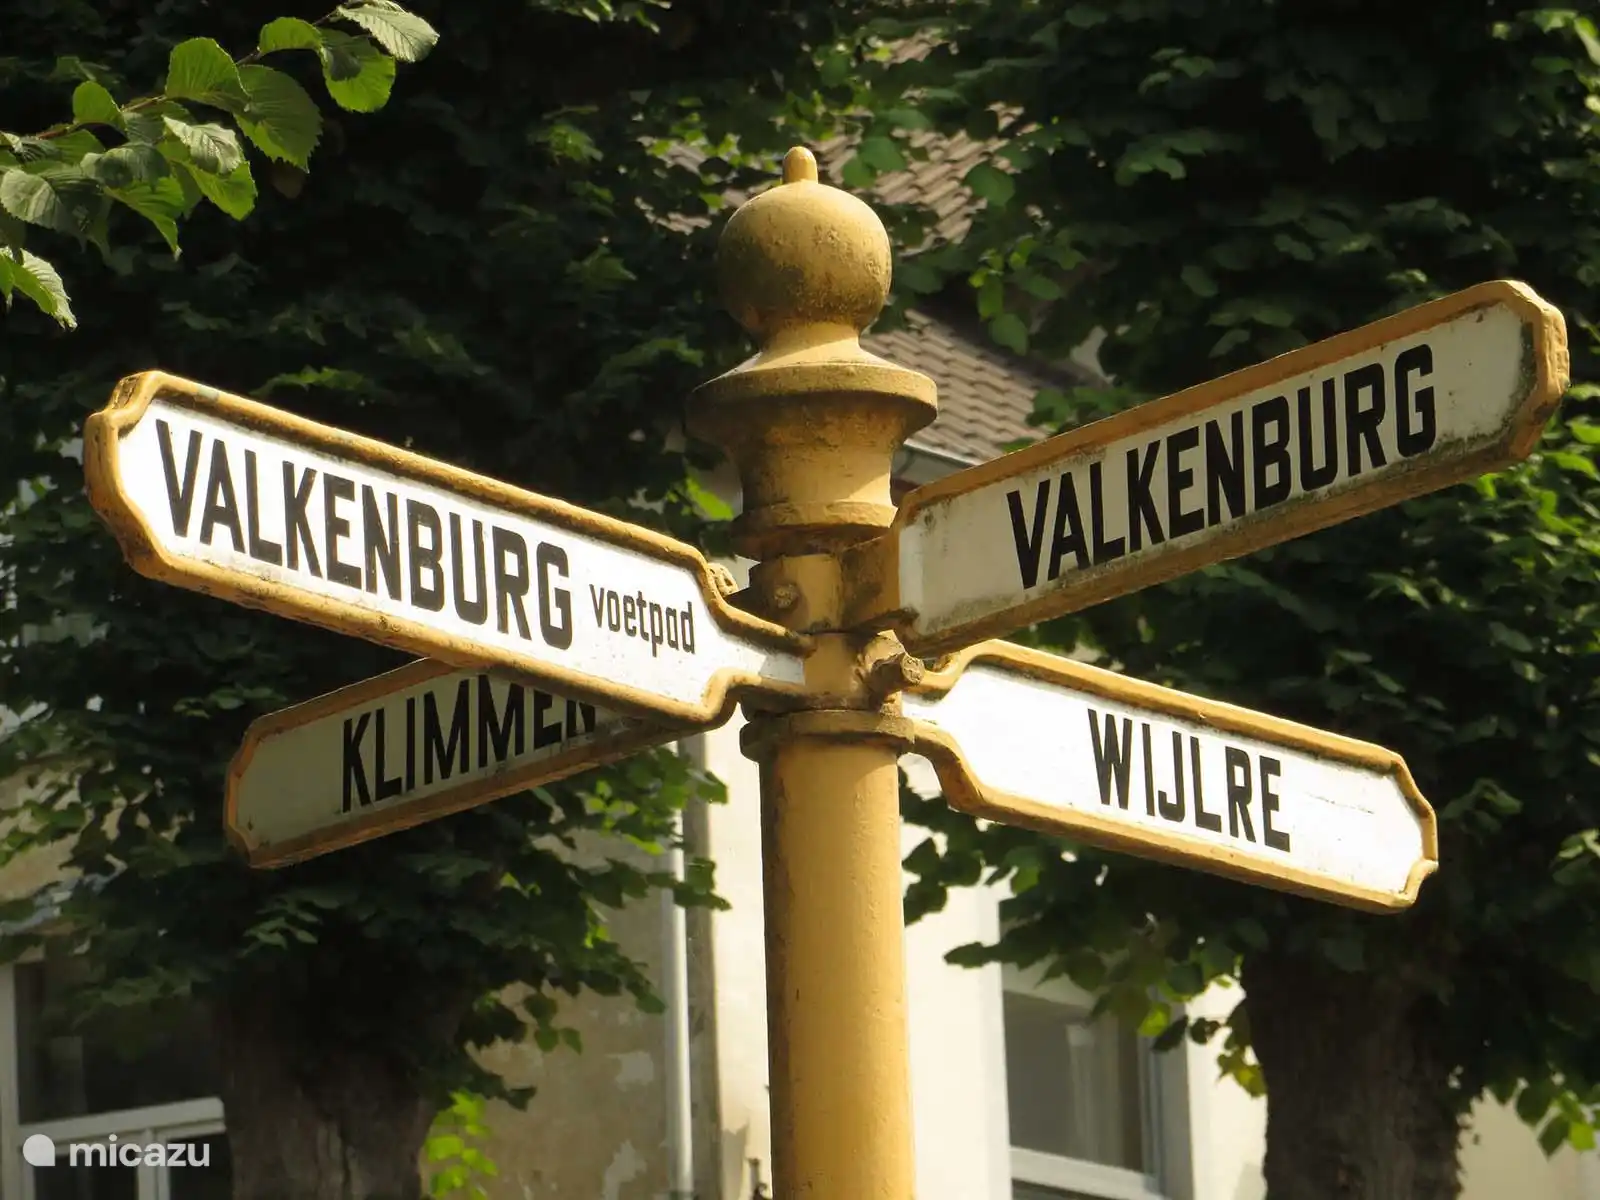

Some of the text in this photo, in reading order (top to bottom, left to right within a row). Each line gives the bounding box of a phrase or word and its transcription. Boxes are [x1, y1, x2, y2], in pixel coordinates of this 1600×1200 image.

[156, 419, 695, 657] VALKENBURG voetpad
[1007, 344, 1436, 589] VALKENBURG
[1087, 708, 1291, 852] WIJLRE
